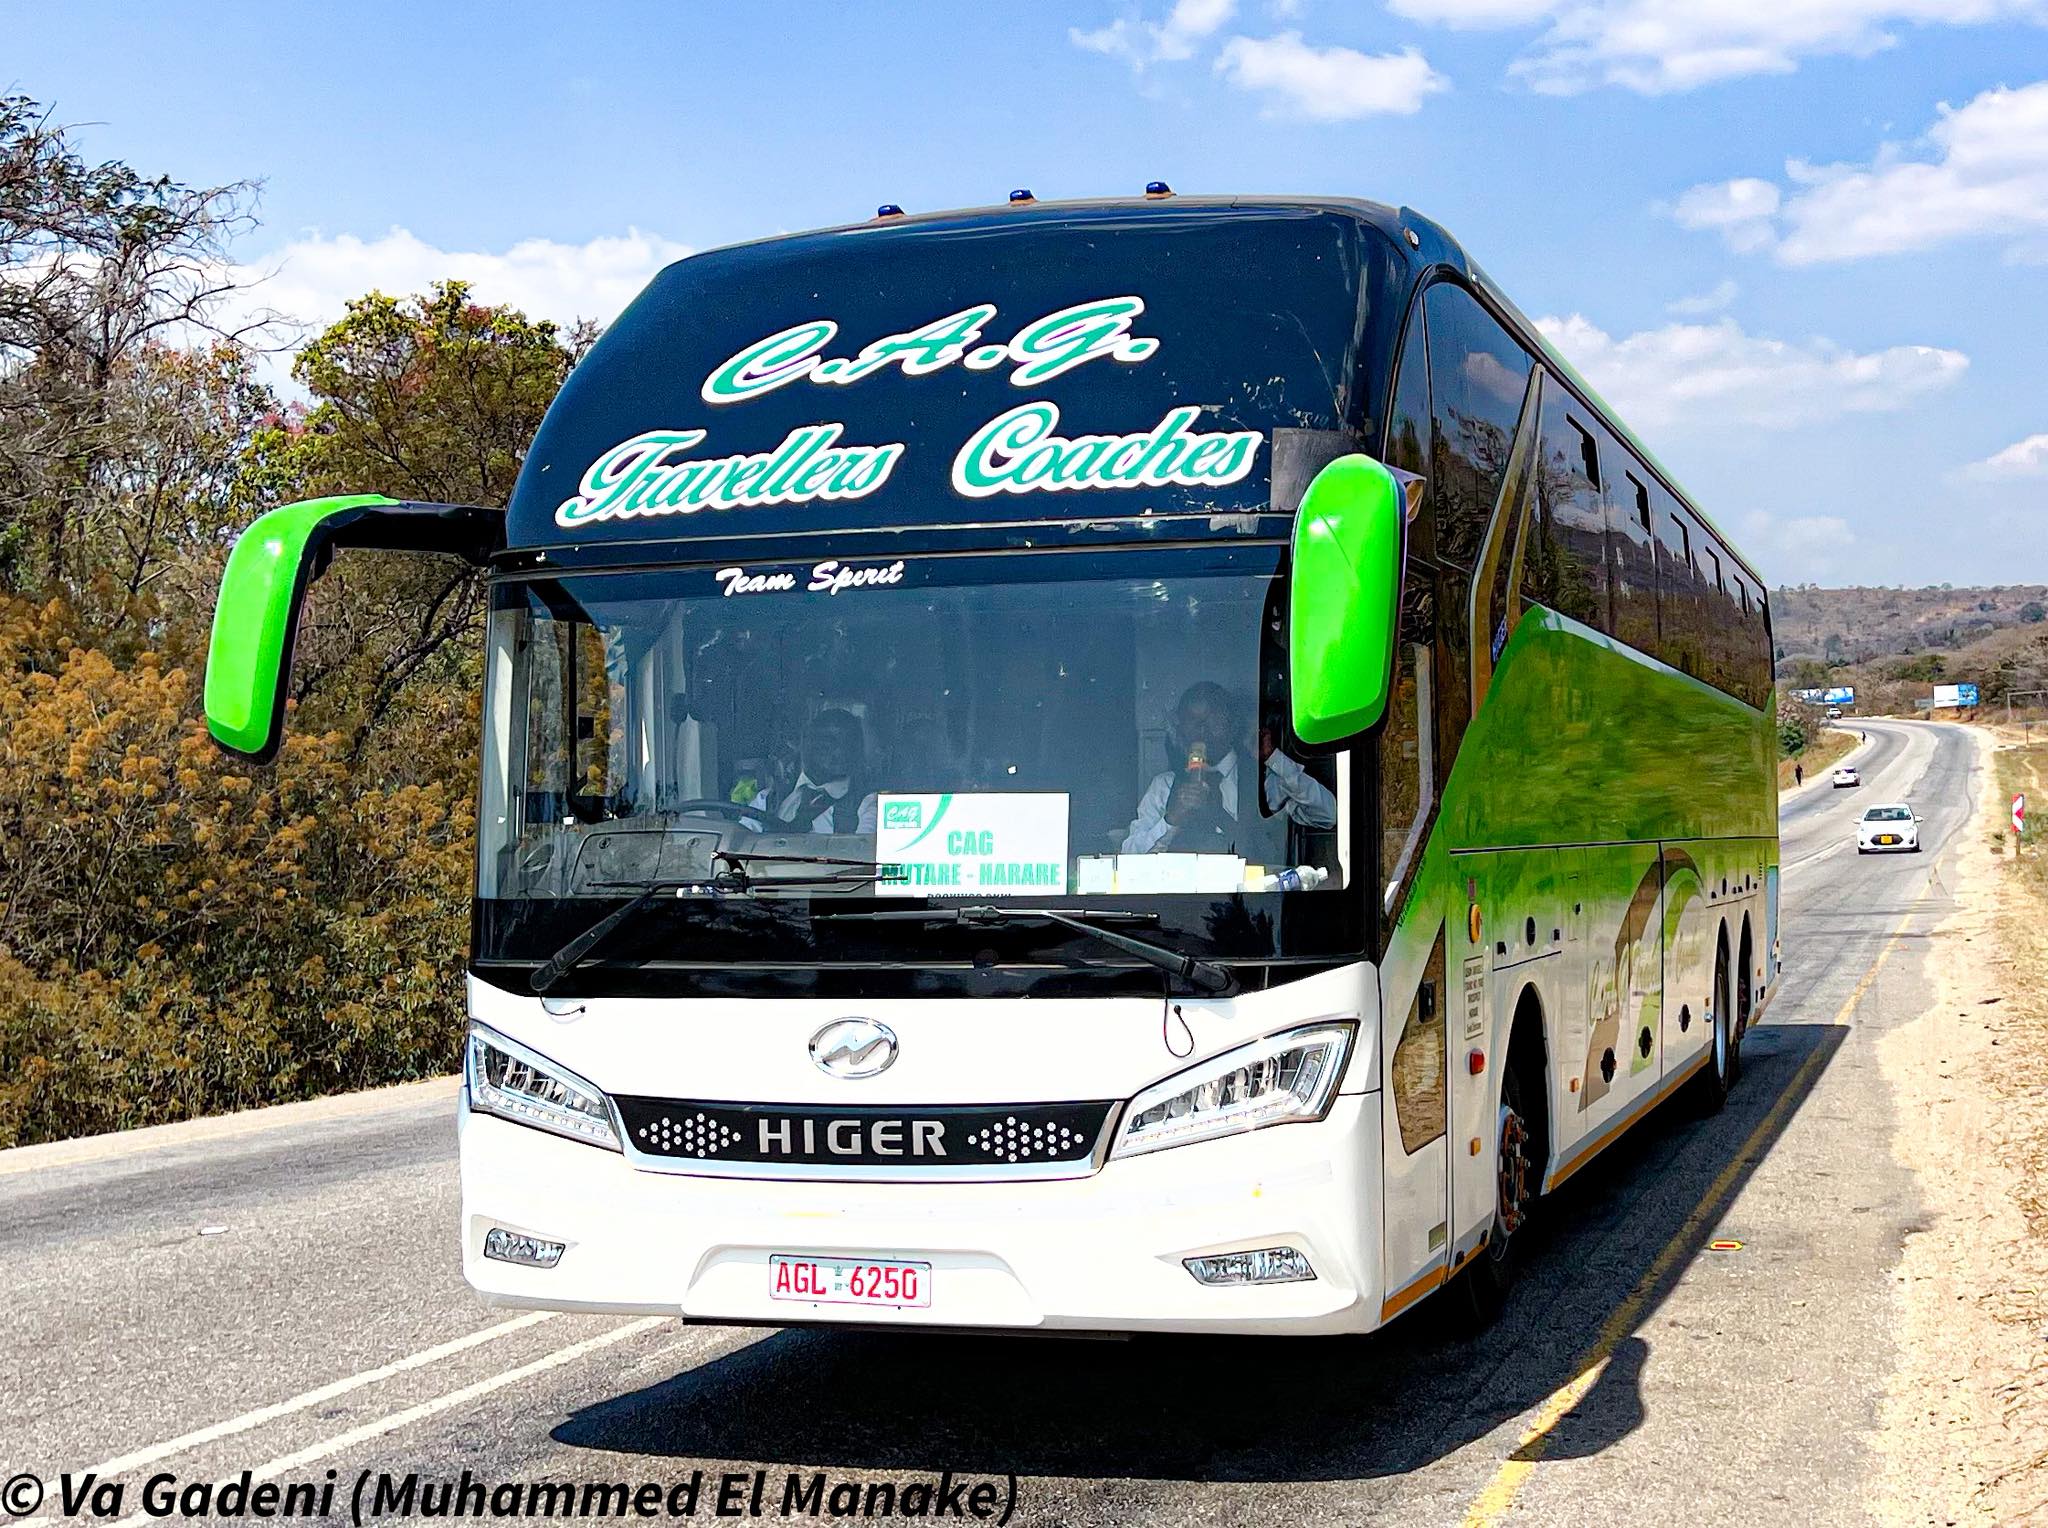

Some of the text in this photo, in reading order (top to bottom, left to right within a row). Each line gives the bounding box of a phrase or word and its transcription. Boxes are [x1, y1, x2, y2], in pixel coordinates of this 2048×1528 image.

[554, 401, 1264, 527] Travellers Coaches
[715, 567, 796, 597] Team
[946, 829, 994, 856] CAG
[881, 862, 961, 886] MUTARE
[979, 862, 1061, 886] HARARE
[758, 1118, 947, 1156] HIGER
[776, 1262, 917, 1301] AGL 6250
